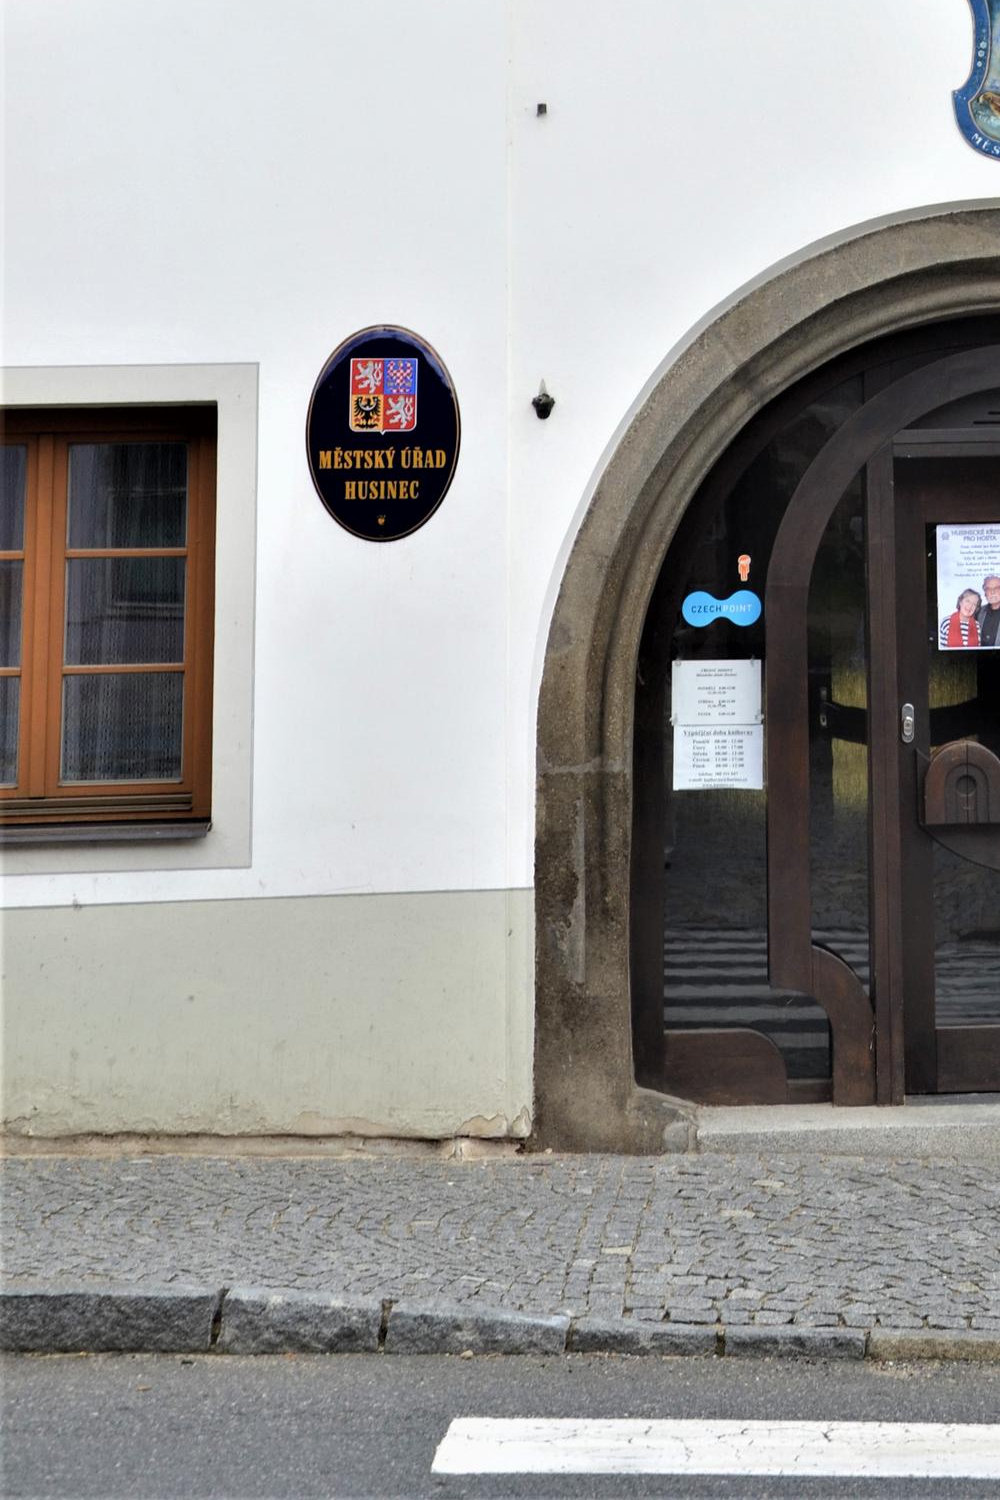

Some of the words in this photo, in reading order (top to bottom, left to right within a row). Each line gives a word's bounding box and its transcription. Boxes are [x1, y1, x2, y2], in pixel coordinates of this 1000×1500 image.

[319, 446, 396, 469] MĚSTSKÝ
[401, 446, 447, 469] ÚŘAD
[344, 480, 420, 500] HUSINEC
